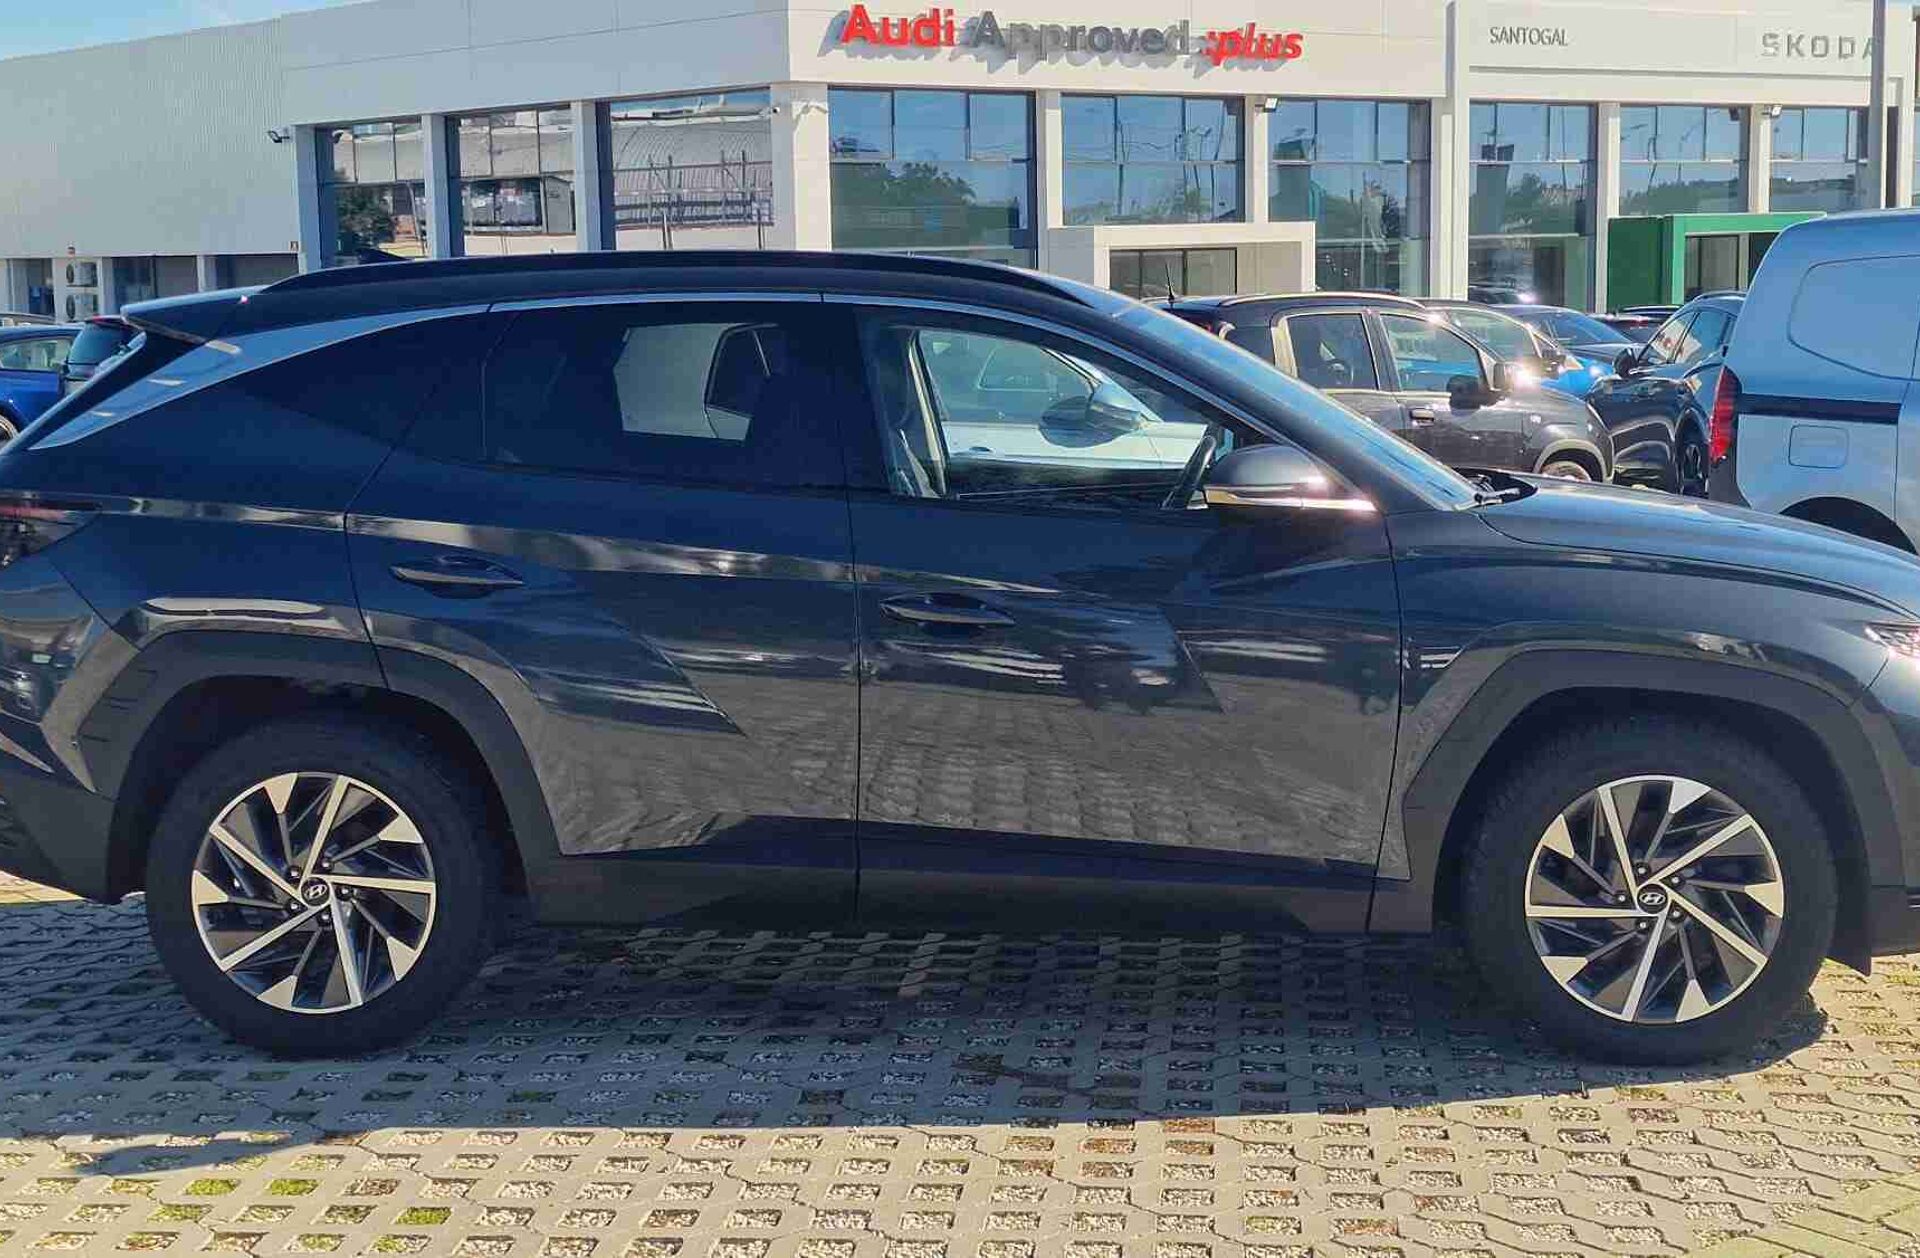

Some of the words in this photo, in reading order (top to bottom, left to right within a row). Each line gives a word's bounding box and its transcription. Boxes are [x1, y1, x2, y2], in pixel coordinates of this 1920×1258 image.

[841, 4, 955, 47] Audi
[974, 11, 1190, 60] Approved
[1490, 26, 1569, 46] SANTOGAL
